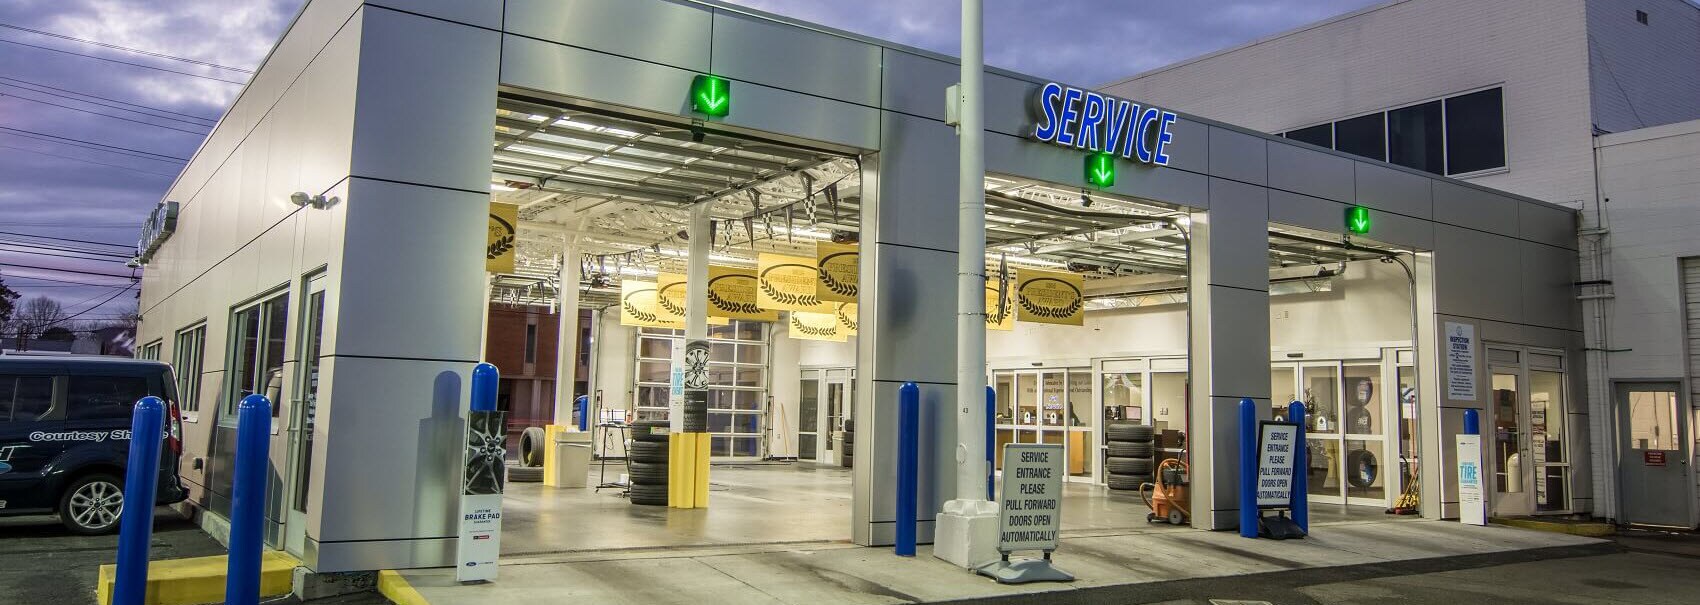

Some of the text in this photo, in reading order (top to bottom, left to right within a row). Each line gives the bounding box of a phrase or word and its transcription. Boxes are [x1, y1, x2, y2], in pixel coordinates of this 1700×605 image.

[1036, 82, 1177, 166] SERVICE
[30, 430, 107, 442] Courtesy
[1271, 432, 1288, 441] SERVICE
[1267, 444, 1289, 453] ENTRANCE
[1021, 452, 1049, 462] SERVICE
[1269, 456, 1285, 464] PLEASE
[1016, 468, 1051, 478] ENTRANCE
[1260, 467, 1291, 475] PULL FORWARD
[1460, 466, 1477, 479] TIRE
[1262, 479, 1288, 488] DOORS OPEN
[1020, 484, 1045, 494] PLEASE
[1257, 491, 1290, 499] AUTOMATICALLY
[1006, 499, 1056, 510] PULL FORWARD
[1009, 515, 1050, 526] DOORS OPEN
[1001, 530, 1056, 542] AUTOMATICALLY
